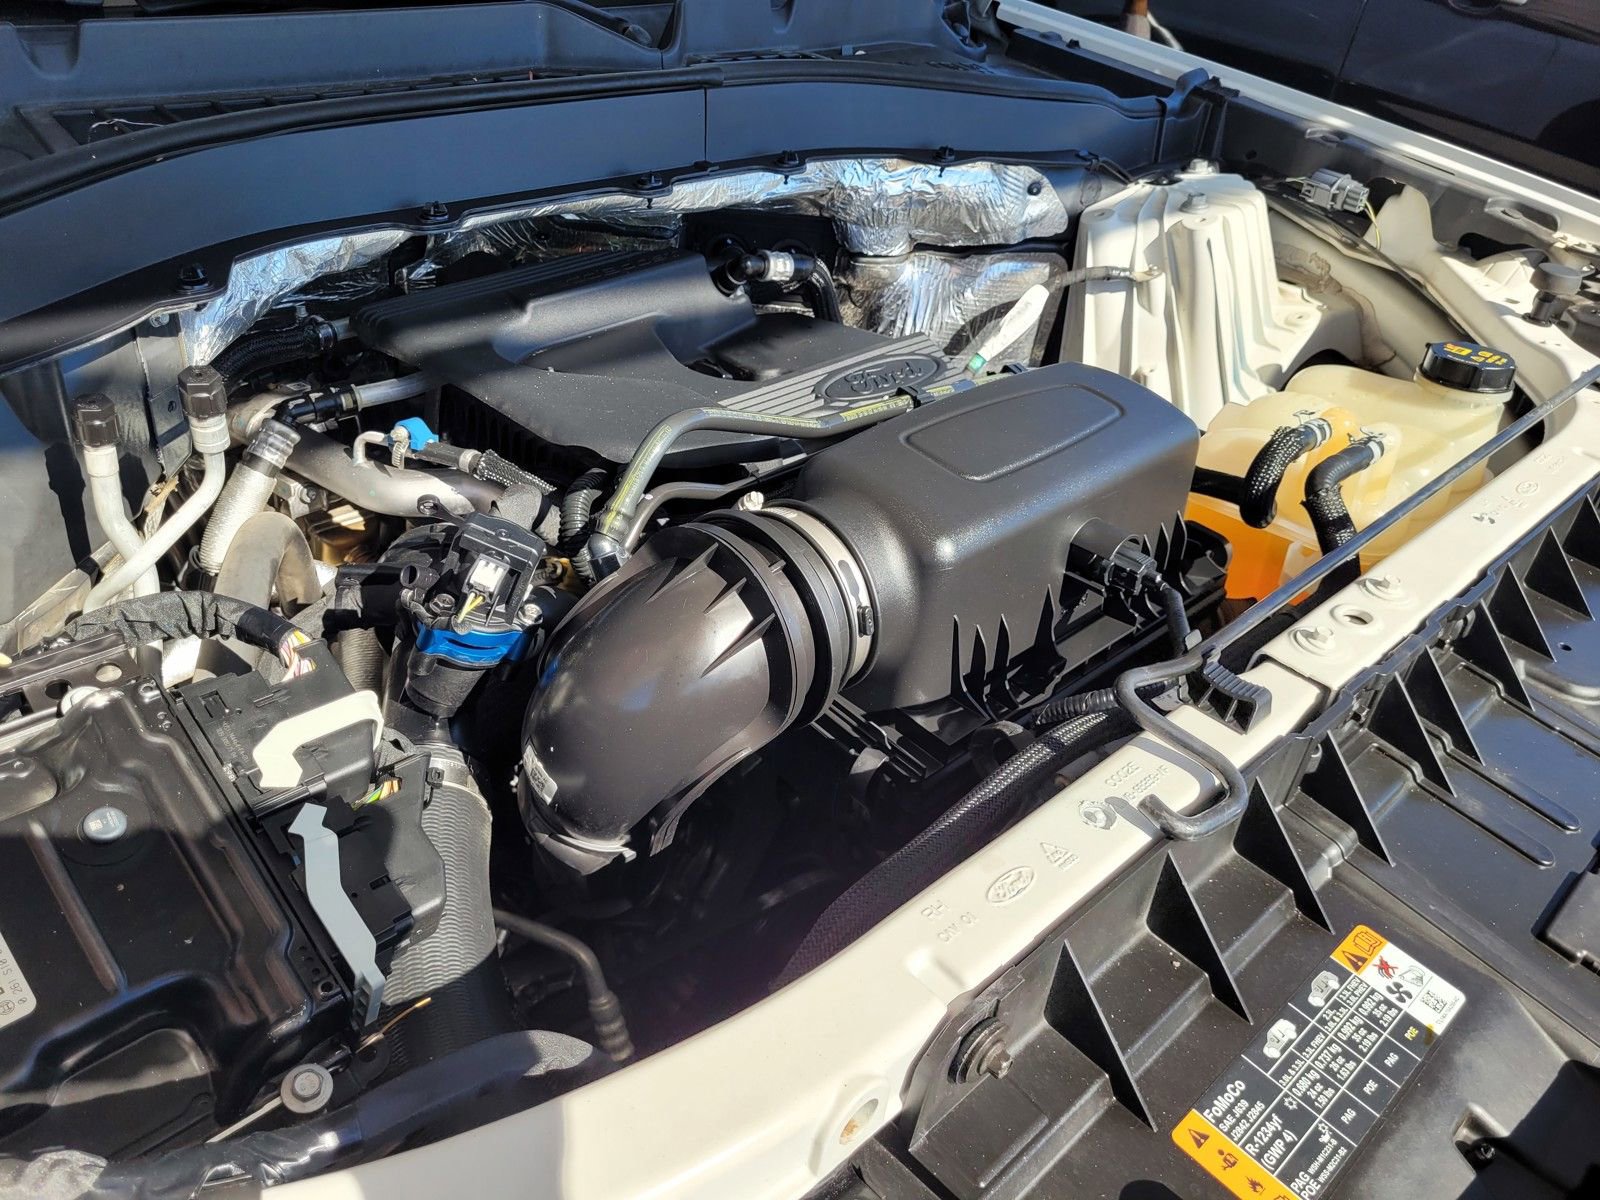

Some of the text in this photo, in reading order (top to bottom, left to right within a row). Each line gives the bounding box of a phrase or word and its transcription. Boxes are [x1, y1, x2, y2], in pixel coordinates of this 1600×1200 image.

[844, 361, 923, 395] Ford
[7, 977, 23, 995] 261
[1357, 989, 1384, 1016] 0.992 kg
[1378, 1002, 1387, 1012] oz
[1387, 1006, 1398, 1017] lbs
[1336, 1013, 1364, 1040] 0.992 kg
[1351, 1026, 1367, 1042] 35 oz
[1403, 1025, 1419, 1041] POE
[1310, 1031, 1326, 1048] FHEV
[1358, 1030, 1378, 1052] 2.19 lbs
[1313, 1041, 1342, 1069] 0.737 kg
[1335, 1055, 1345, 1064] oz
[1383, 1051, 1399, 1067] PAG
[1304, 1067, 1320, 1082] kg
[1335, 1058, 1357, 1081] 1.63 lbs
[1307, 1082, 1323, 1099] 24 oz
[1313, 1085, 1335, 1109] 1.50 lbs
[1361, 1078, 1379, 1096] POE
[1202, 1075, 1247, 1125] FoMoCo
[1219, 1098, 1250, 1132] SAE J639
[1229, 1099, 1266, 1141] J2842 J2845
[1340, 1107, 1357, 1124] PAG
[1243, 1112, 1285, 1158] R-1234yf
[1259, 1128, 1298, 1171] (GWP 4)
[1289, 1170, 1311, 1193] PAG
[1300, 1178, 1321, 1200] POE
